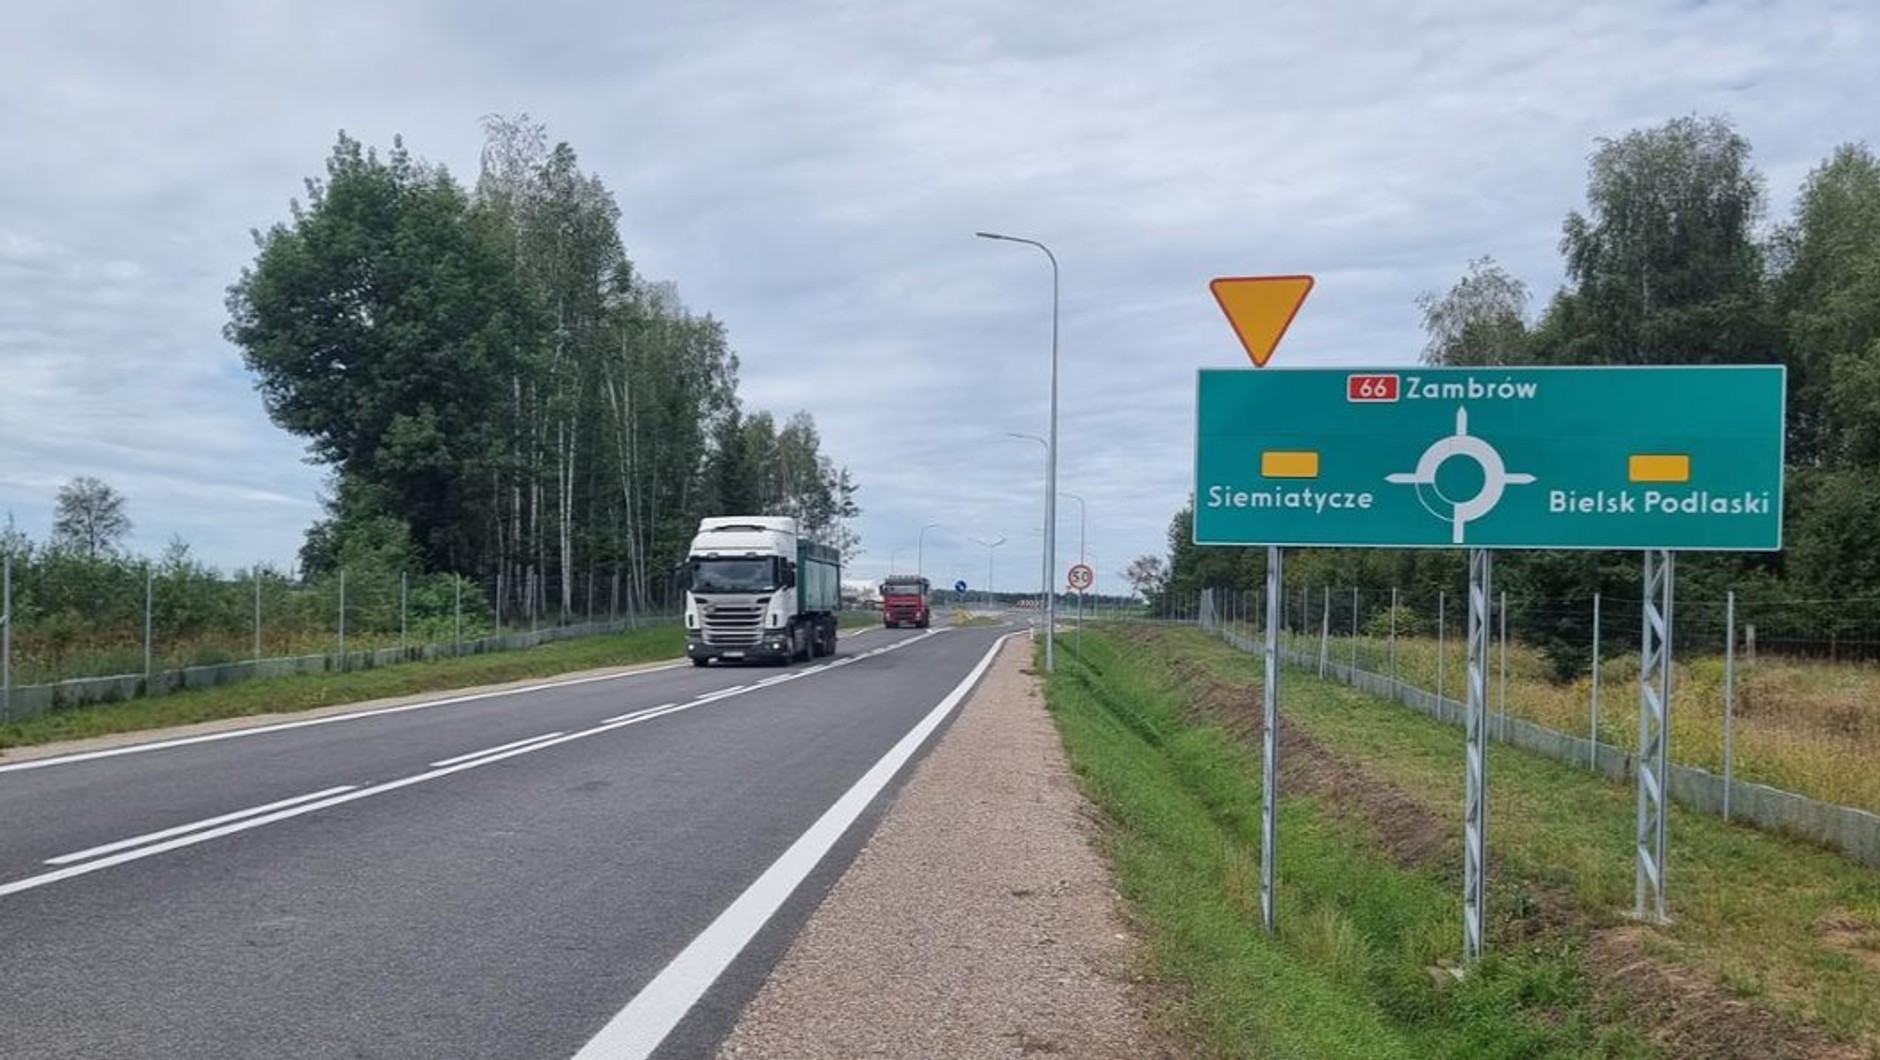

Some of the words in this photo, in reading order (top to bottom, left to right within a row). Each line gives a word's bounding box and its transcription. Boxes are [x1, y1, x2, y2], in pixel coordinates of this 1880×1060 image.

[1359, 378, 1387, 398] 66
[1407, 377, 1537, 399] Zambrów
[1208, 486, 1373, 513] Siemiatycze
[1549, 490, 1635, 513] Bielsk
[1645, 491, 1770, 514] Podlaski
[1073, 571, 1089, 583] 50
